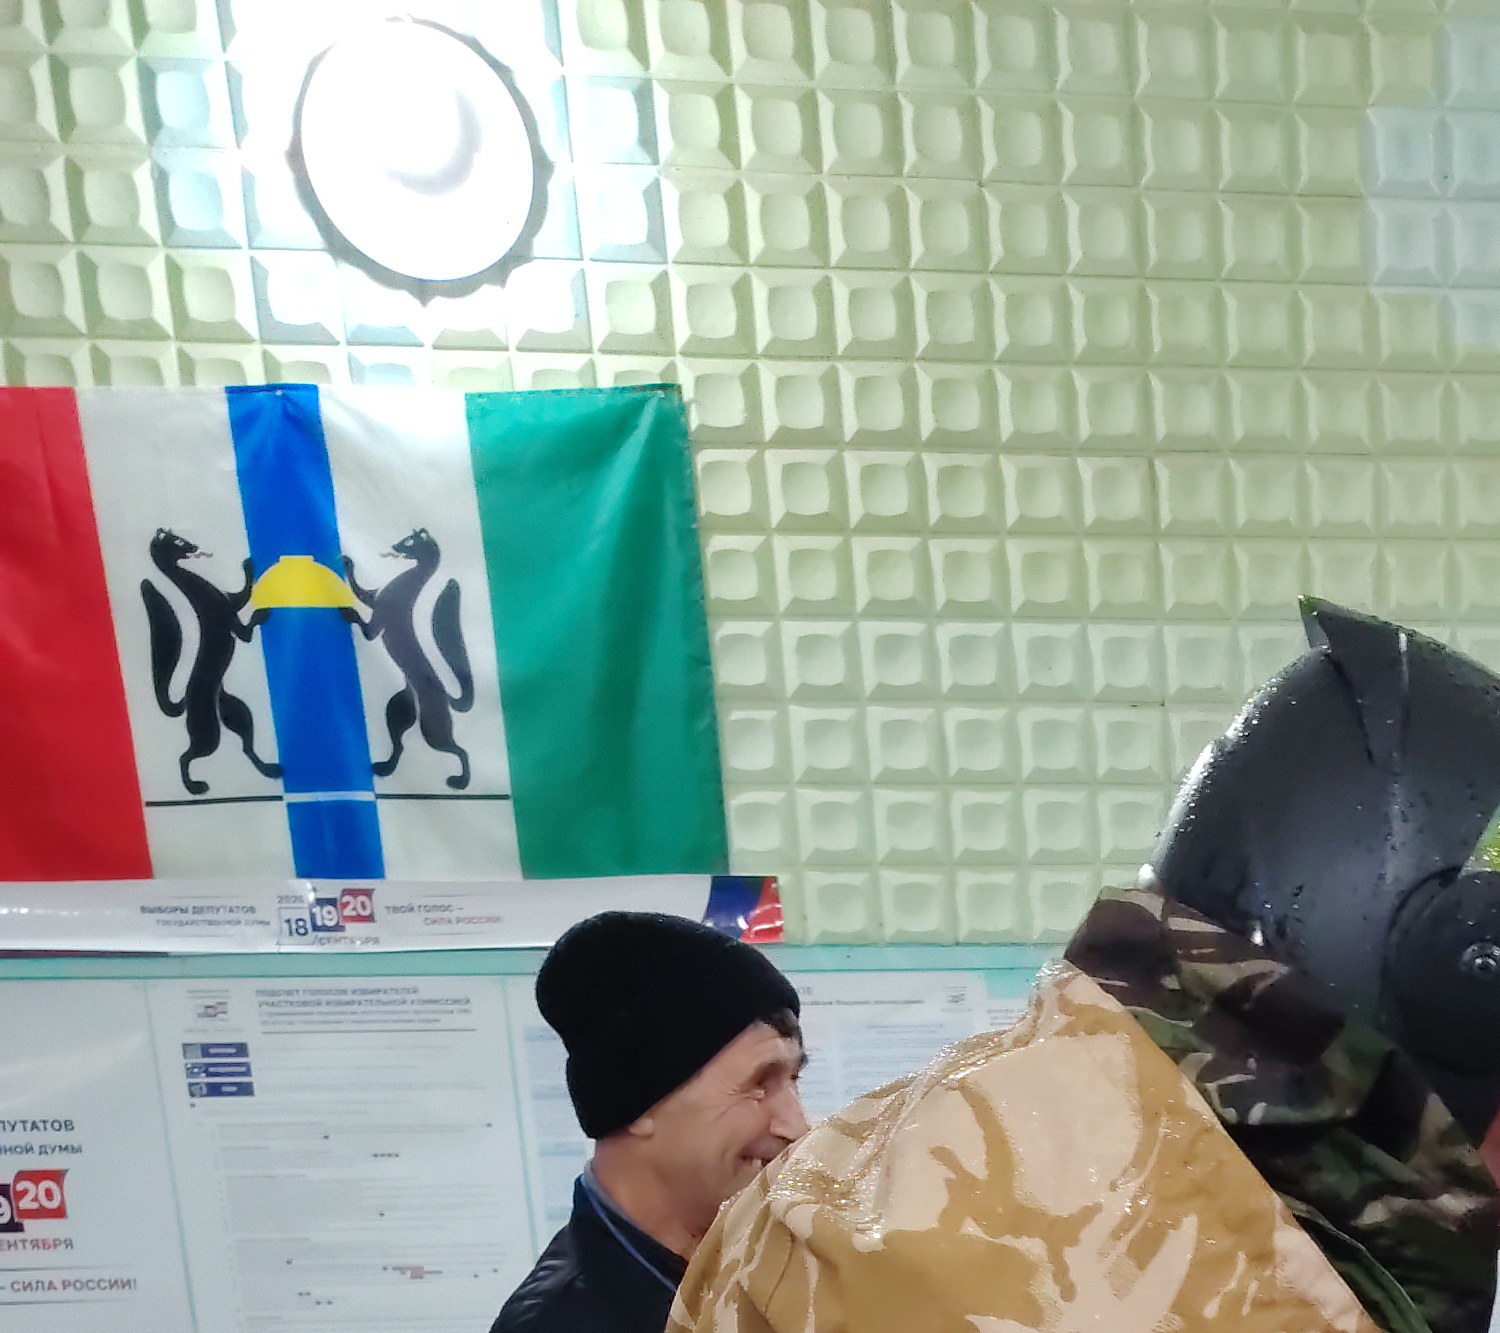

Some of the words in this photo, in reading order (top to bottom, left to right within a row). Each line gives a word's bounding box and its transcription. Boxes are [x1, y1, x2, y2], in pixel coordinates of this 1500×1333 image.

[284, 917, 309, 937] 18
[312, 905, 338, 926] 19
[341, 895, 373, 916] 20
[39, 1143, 83, 1156] ДУМЫ
[15, 1180, 62, 1210] 20
[10, 1280, 58, 1293] СИЛА
[61, 1278, 137, 1292] РОССИИ!
